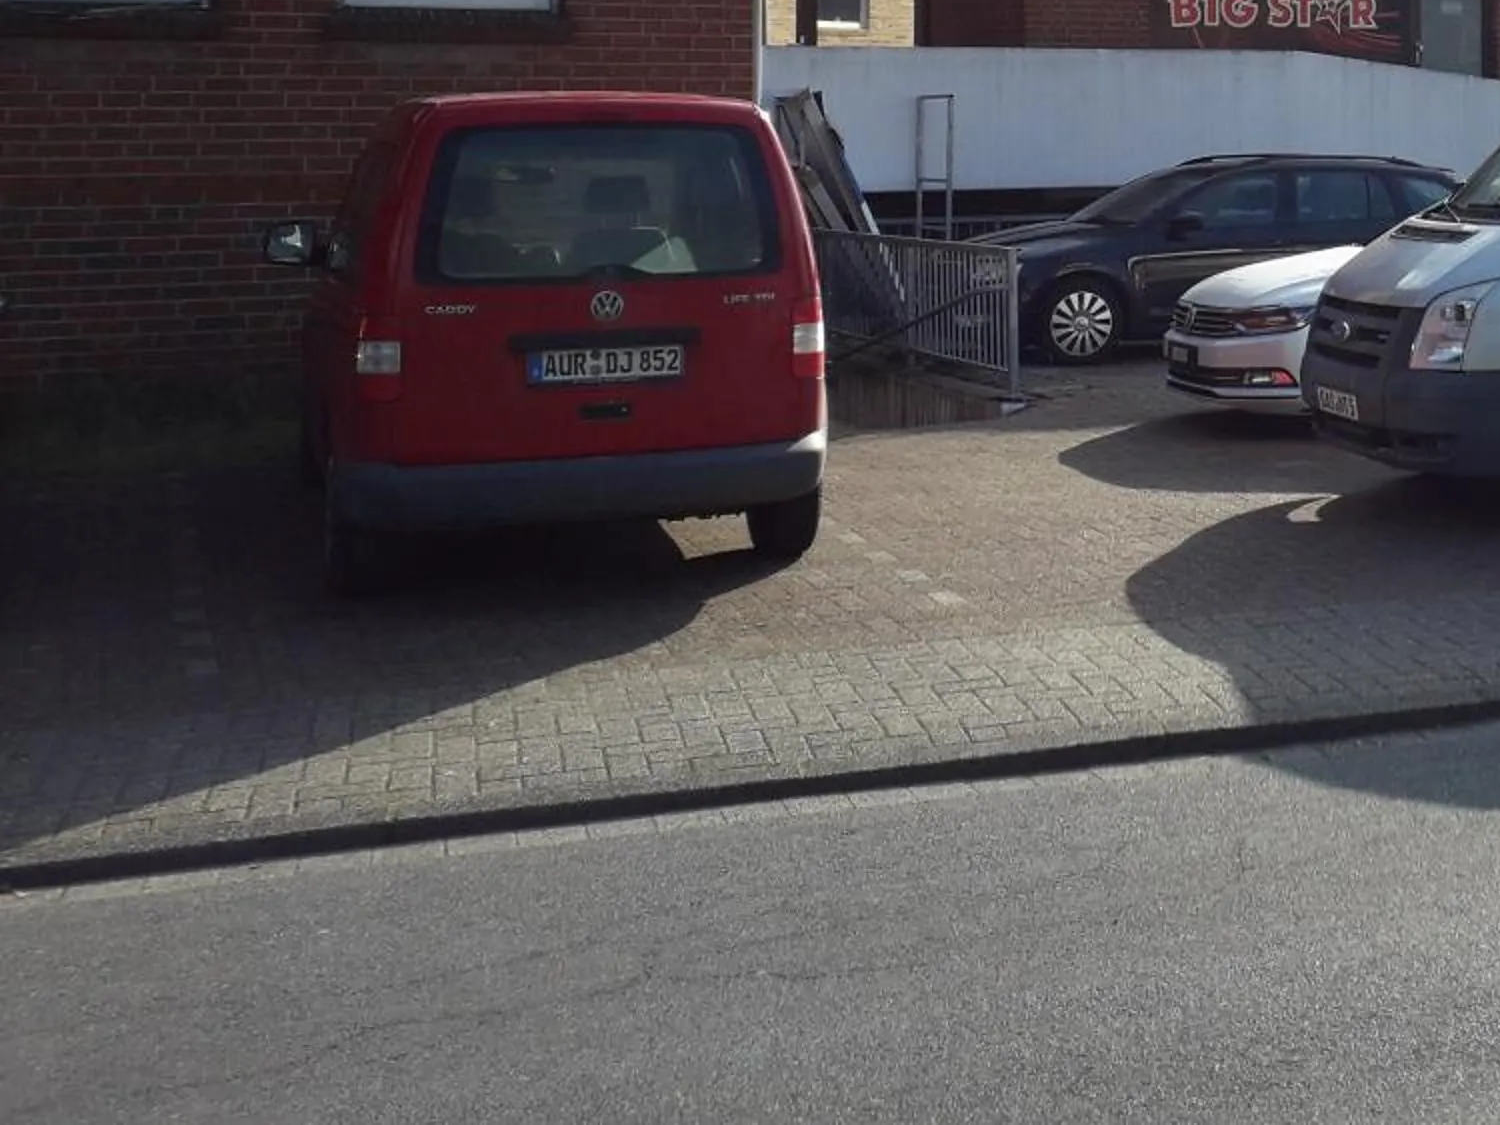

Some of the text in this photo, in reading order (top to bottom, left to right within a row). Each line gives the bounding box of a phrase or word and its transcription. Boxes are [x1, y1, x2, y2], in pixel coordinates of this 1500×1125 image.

[425, 305, 476, 314] CADDY
[544, 348, 680, 377] AUR DJ 852
